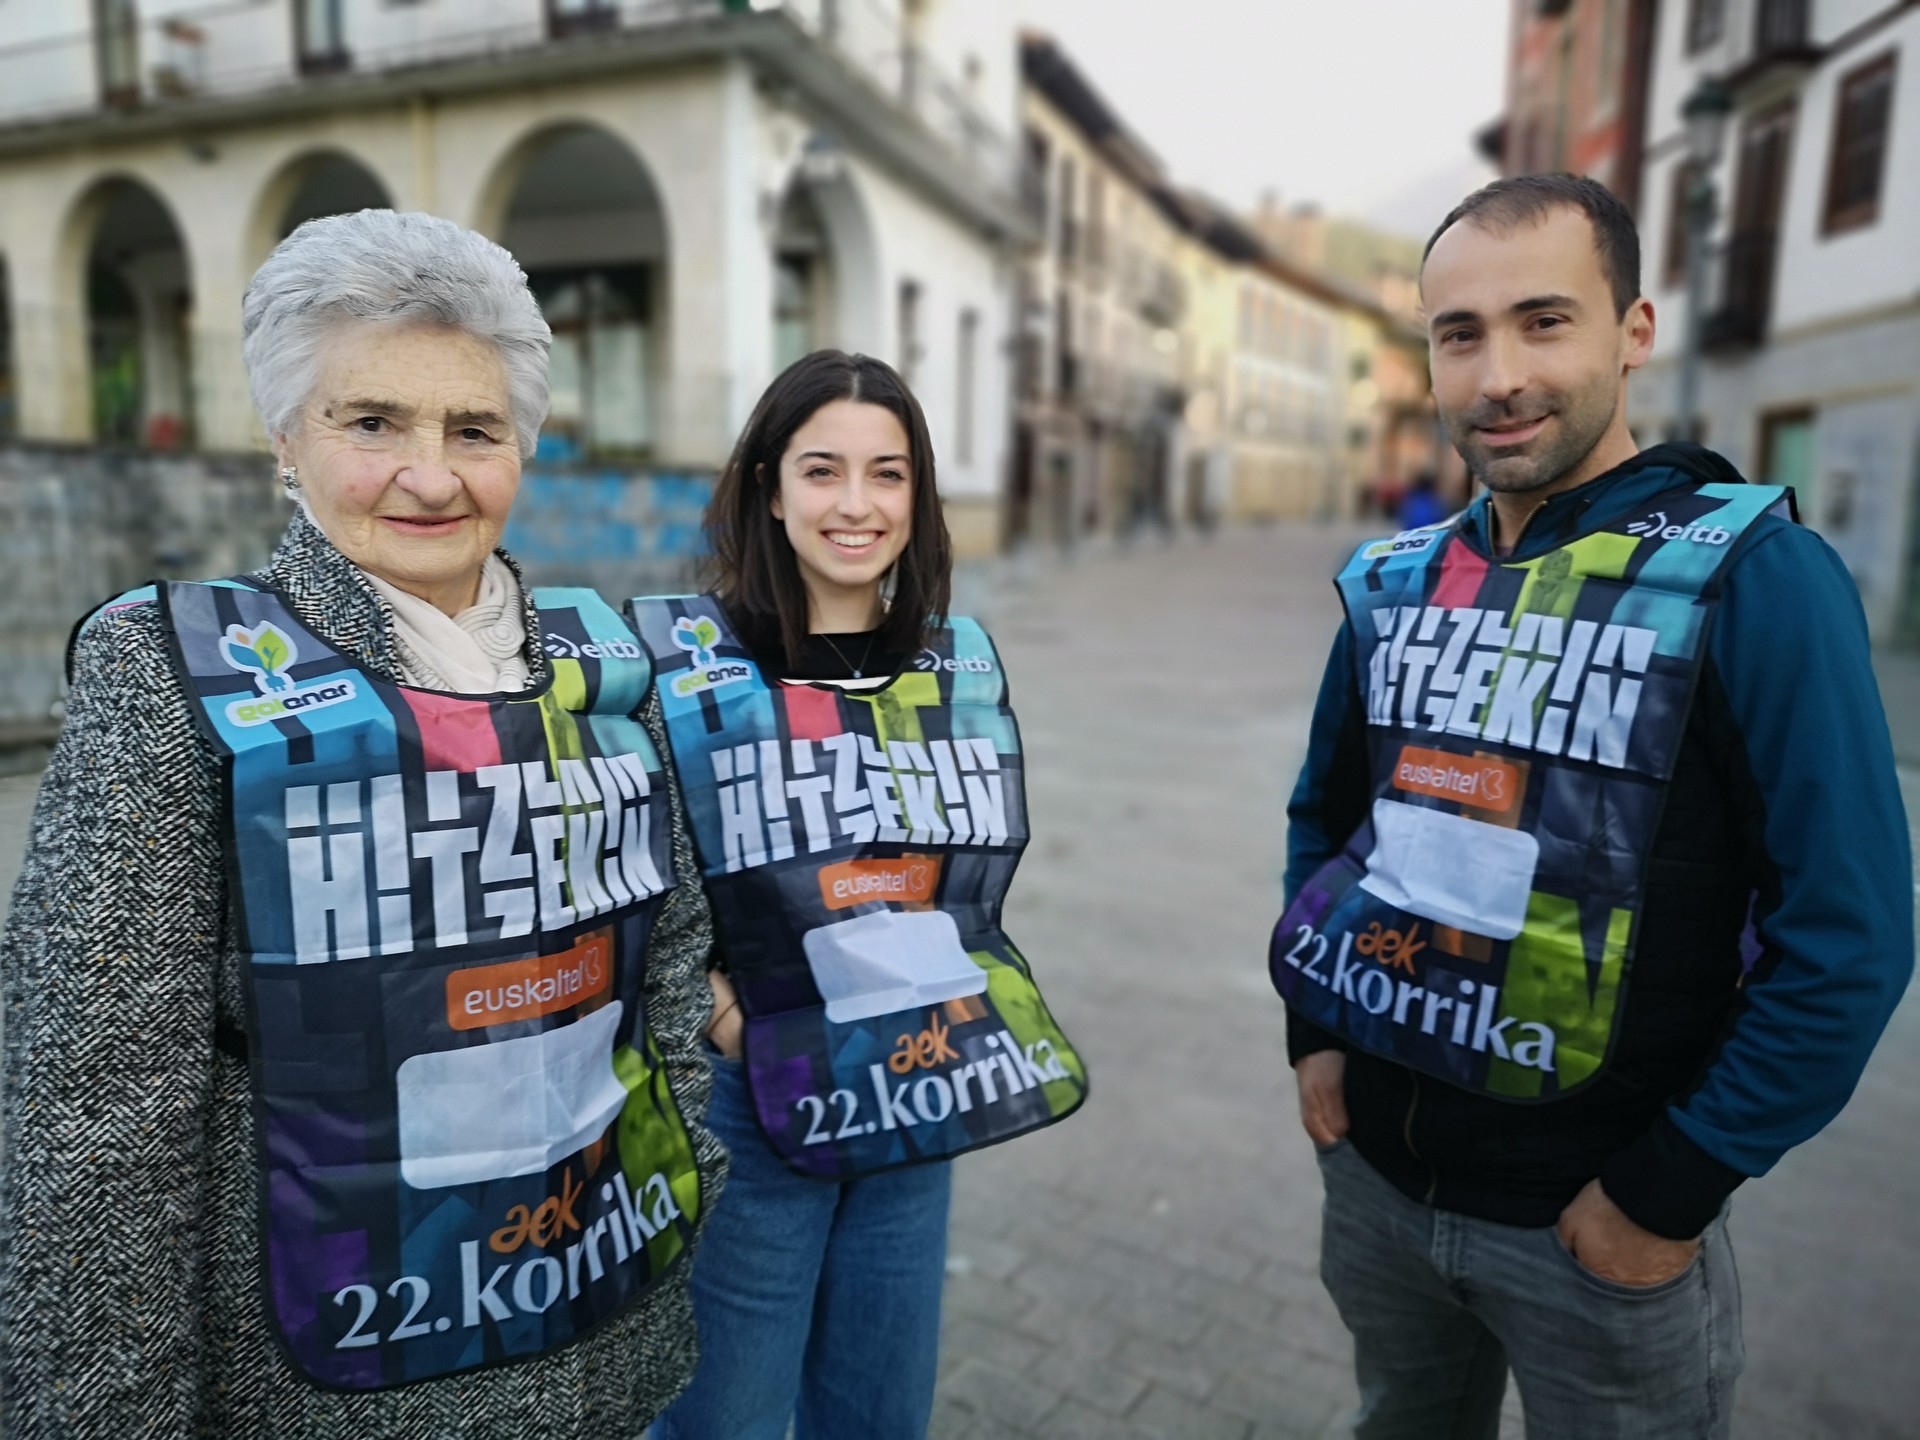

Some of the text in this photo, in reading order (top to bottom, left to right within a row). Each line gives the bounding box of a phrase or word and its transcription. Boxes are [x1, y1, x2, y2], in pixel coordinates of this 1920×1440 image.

[1661, 521, 1731, 545] eitb
[581, 638, 641, 659] eitb
[942, 655, 992, 672] eitb
[1400, 763, 1479, 794] euskaltel
[832, 870, 907, 898] euskaltel
[1355, 921, 1427, 976] aek
[463, 960, 584, 1015] euskaltel
[888, 1011, 960, 1074] aek
[489, 1167, 585, 1253] aek
